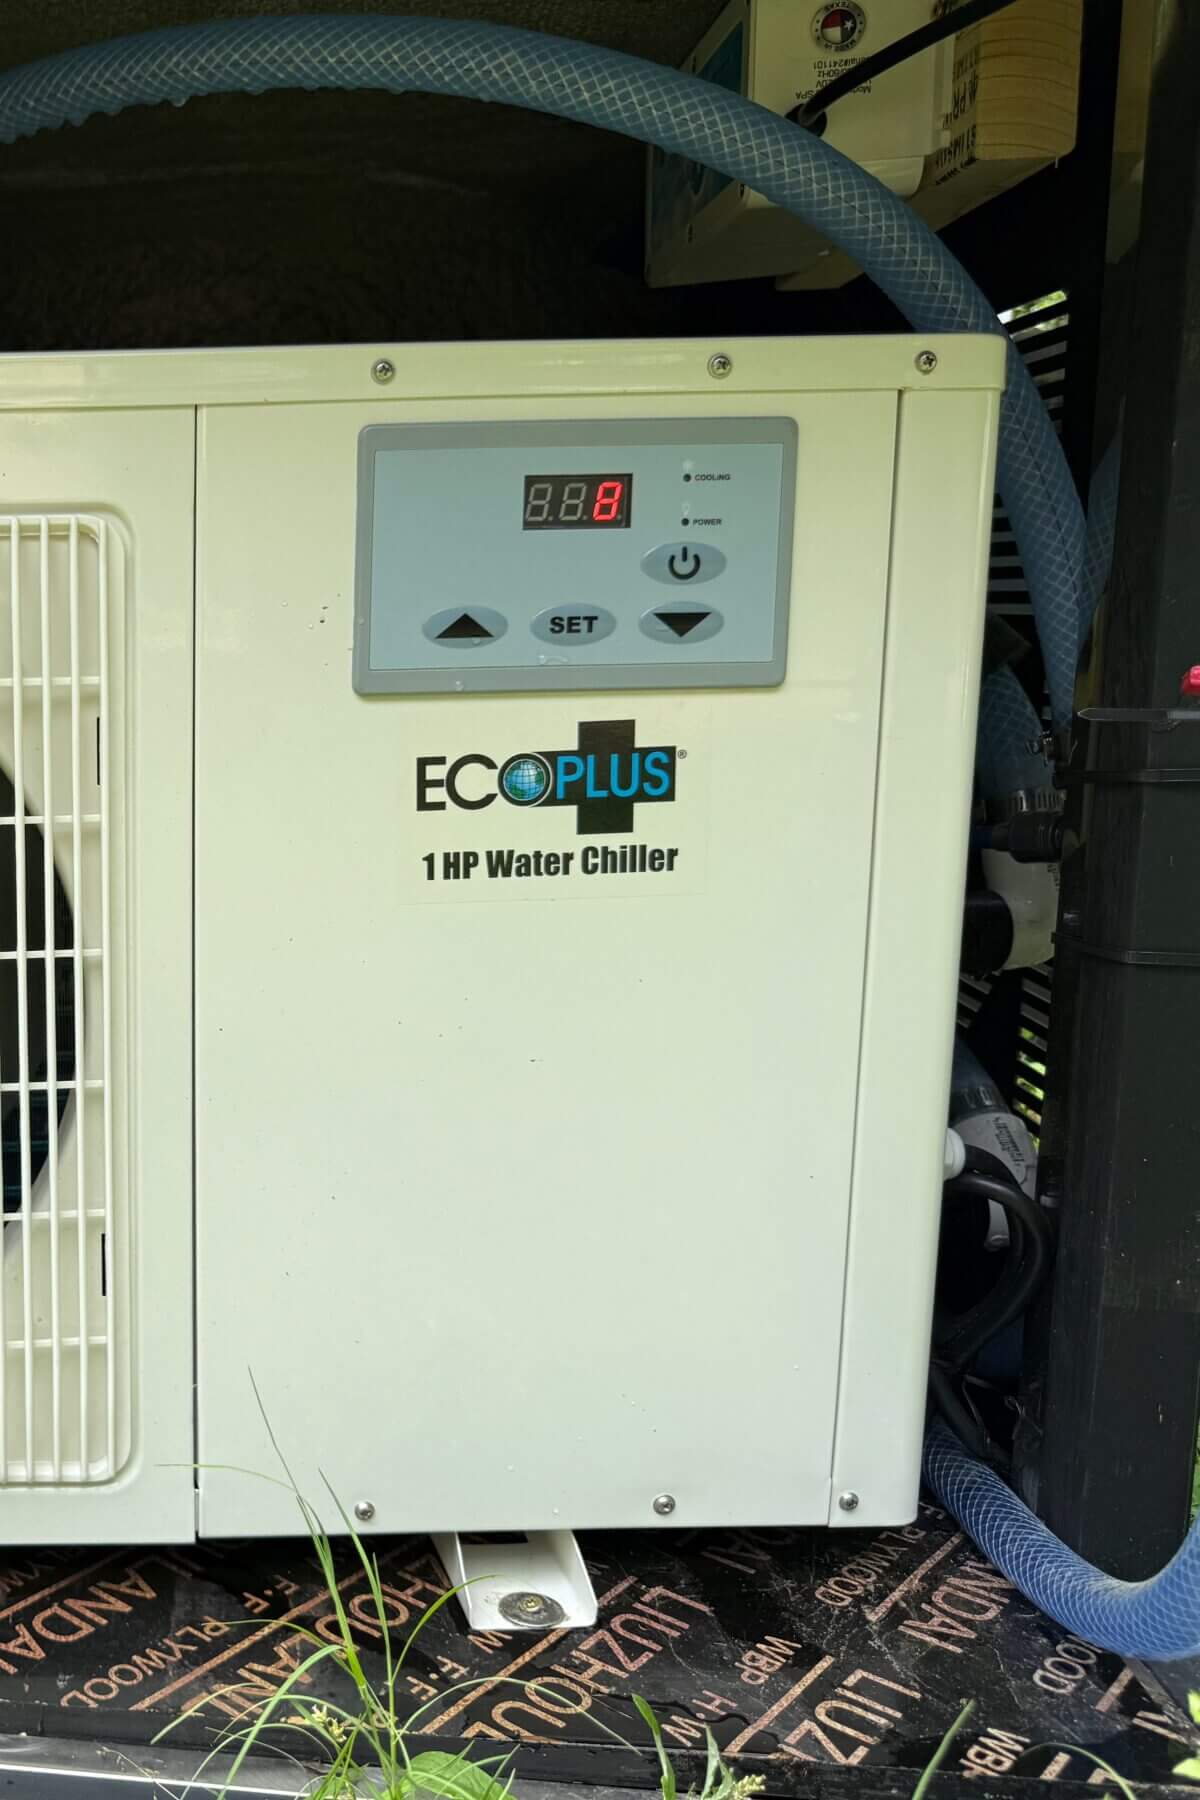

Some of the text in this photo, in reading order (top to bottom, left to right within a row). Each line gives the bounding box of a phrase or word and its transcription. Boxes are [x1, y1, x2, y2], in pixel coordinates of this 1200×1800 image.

[694, 473, 731, 481] COOLING
[692, 518, 723, 526] POWER
[549, 615, 598, 635] SET
[422, 844, 679, 880] 1 HP Water Chiller
[491, 1586, 714, 1744] LIUZHOU
[735, 1634, 802, 1685] WBP
